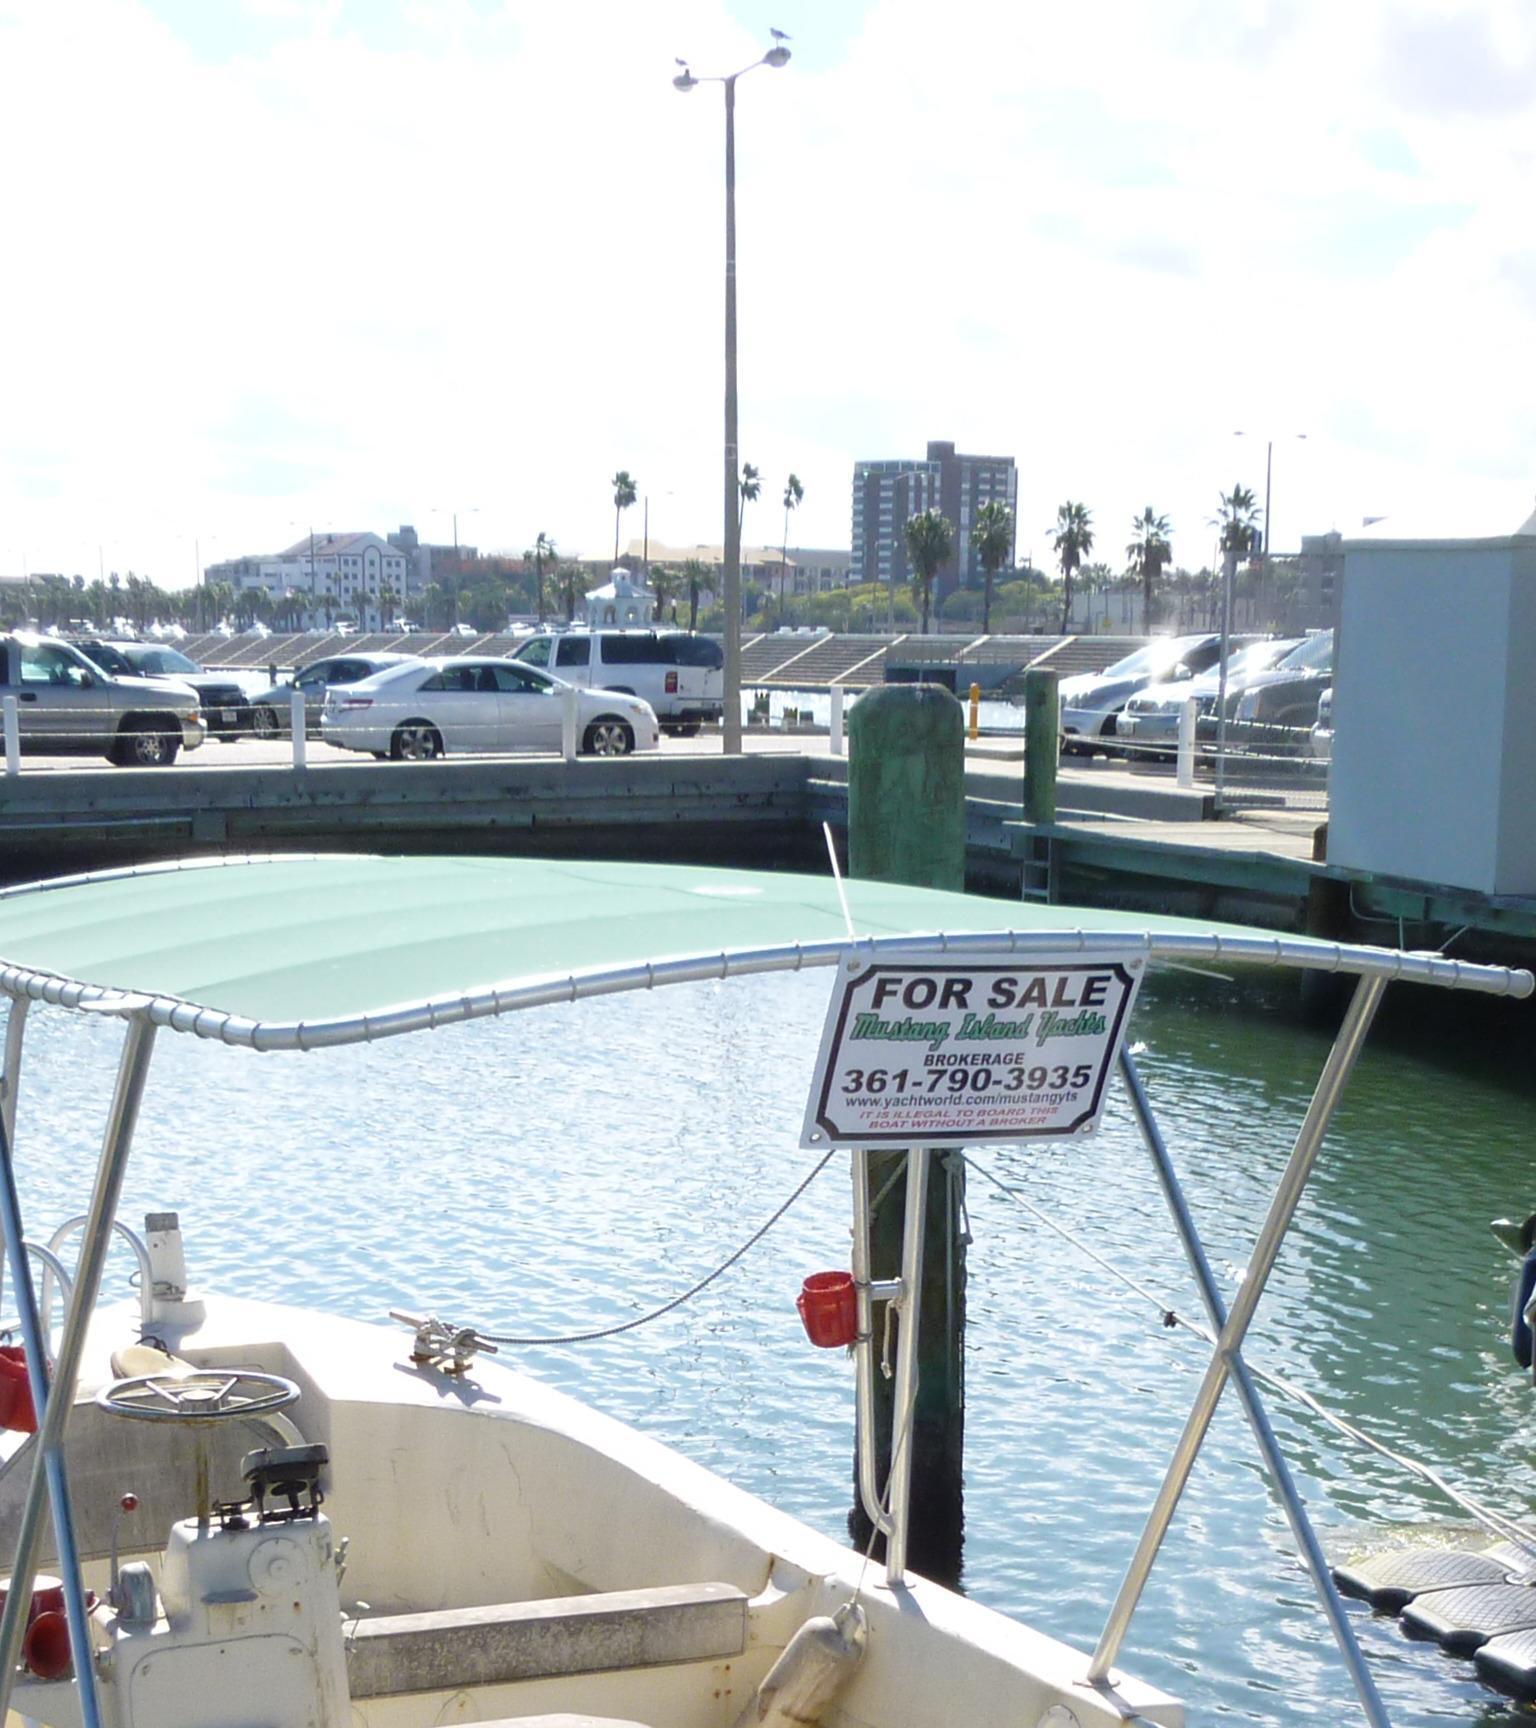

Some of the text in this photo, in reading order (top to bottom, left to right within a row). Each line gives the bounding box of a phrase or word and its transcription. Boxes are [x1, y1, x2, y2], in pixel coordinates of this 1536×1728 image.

[871, 975, 1111, 1010] FOR SALE
[849, 1009, 1107, 1052] Mustang Island Yachts
[924, 1052, 1025, 1068] BROKERAGE
[841, 1064, 1093, 1094] 361-790-3935
[845, 1090, 1078, 1110] www.yachtworld.com/mustangyts
[860, 1106, 1059, 1120] IT IS ILLEGAL TO BOARD THIS
[868, 1116, 1047, 1129] BOAT WITHOUT A BROKER
